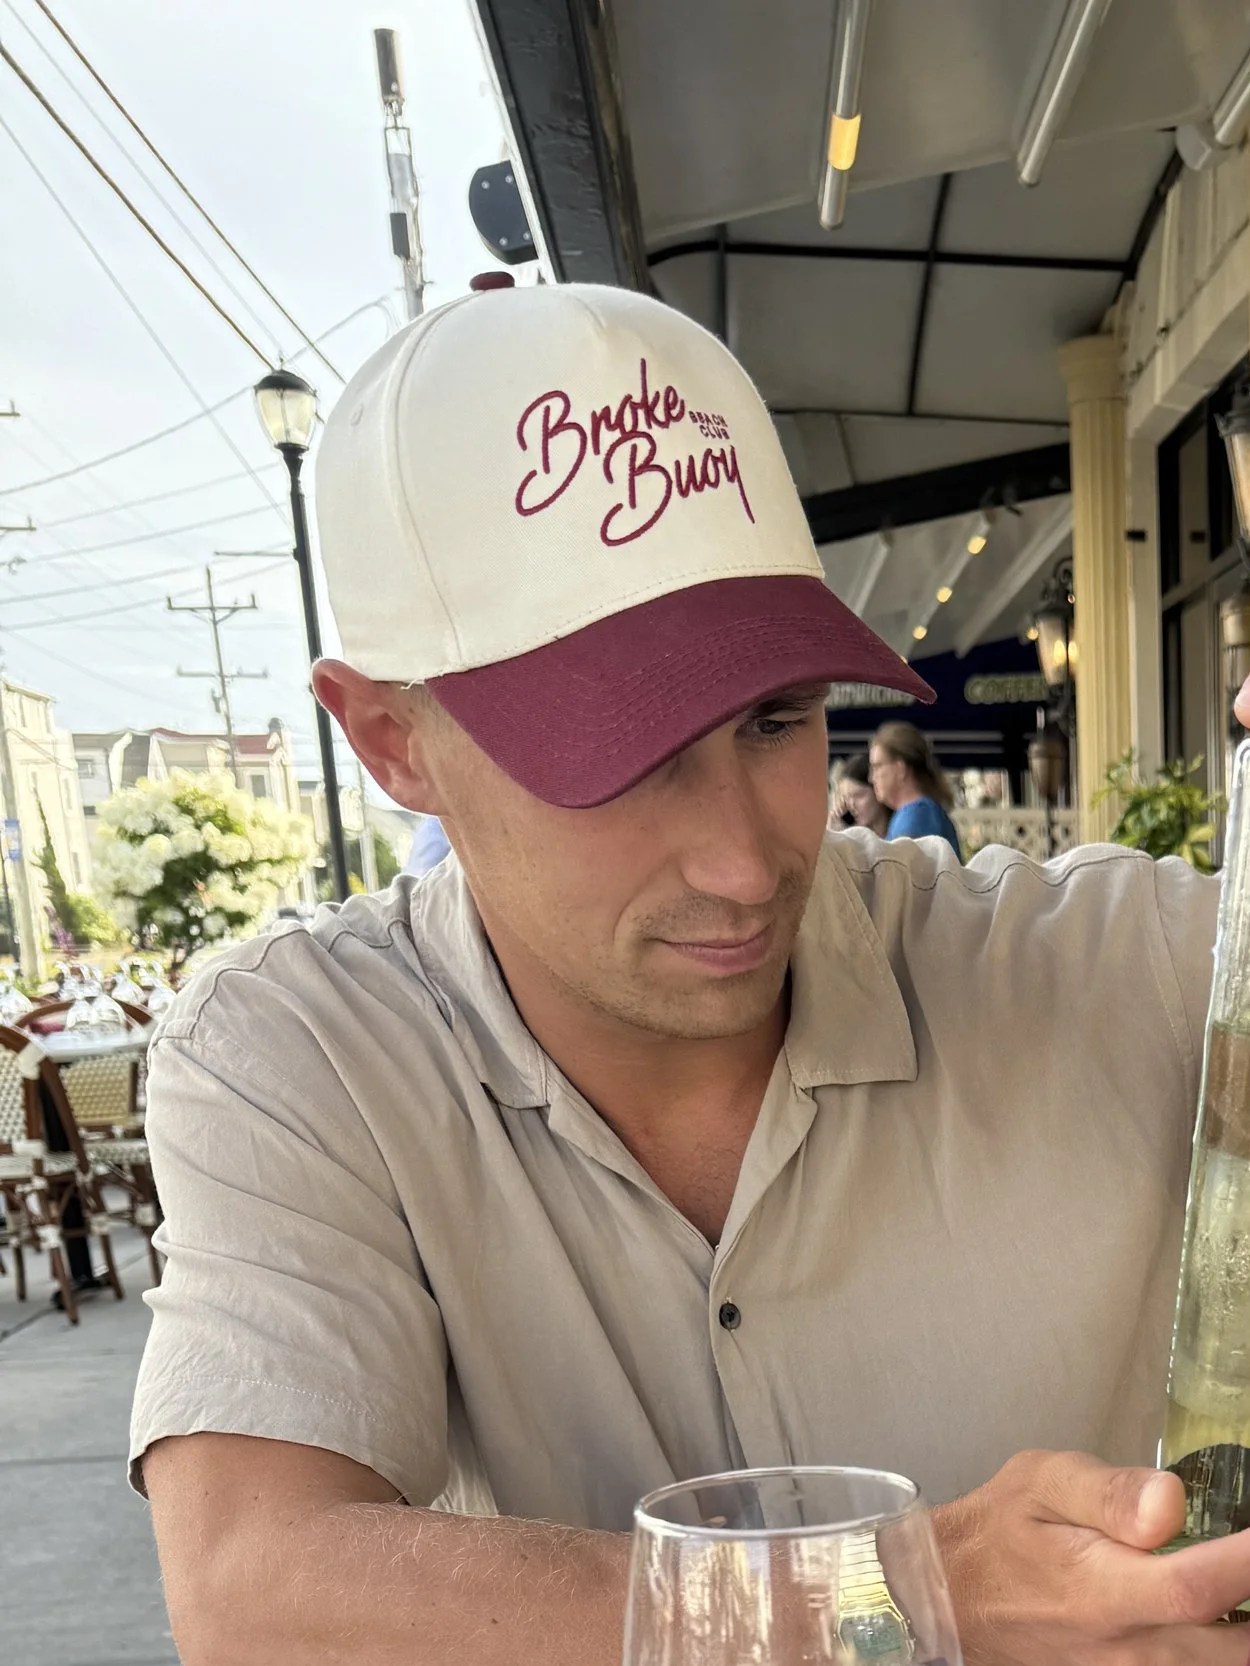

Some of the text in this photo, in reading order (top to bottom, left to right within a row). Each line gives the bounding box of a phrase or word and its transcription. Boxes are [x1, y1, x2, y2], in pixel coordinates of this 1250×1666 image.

[515, 358, 685, 516] Broke
[688, 410, 729, 428] BEACH
[699, 424, 730, 440] CLUB
[600, 431, 755, 546] Buoy
